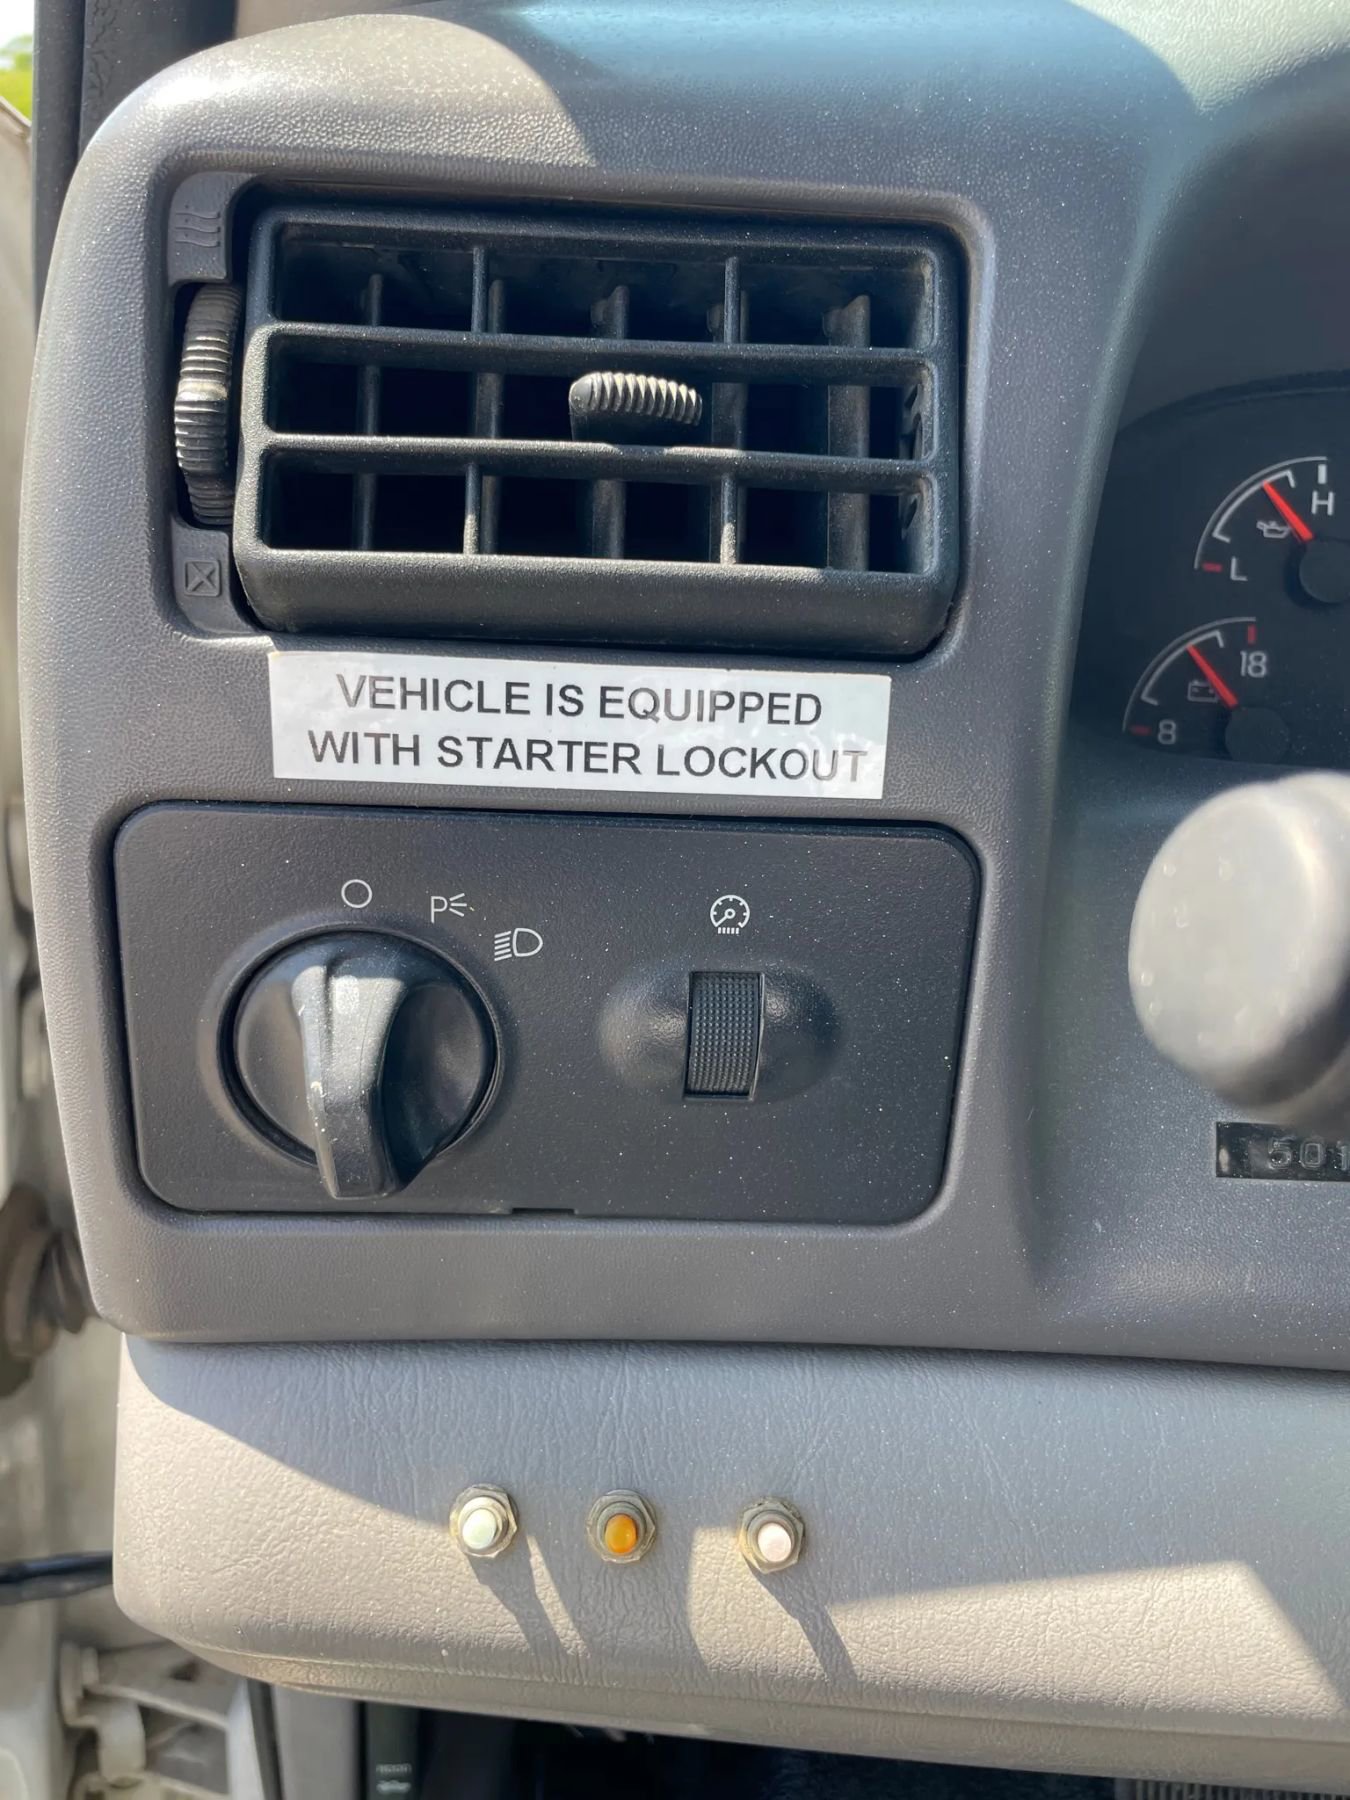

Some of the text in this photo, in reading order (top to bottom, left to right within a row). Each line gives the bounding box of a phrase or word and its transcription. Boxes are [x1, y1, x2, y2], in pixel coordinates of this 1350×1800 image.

[1311, 490, 1335, 516] H
[1230, 556, 1248, 581] L
[1239, 650, 1268, 678] 18
[336, 674, 823, 726] VEHICLE IS EQUIPPED
[1157, 719, 1177, 745] 8
[307, 730, 869, 783] WITH STARTER LOCKOUT
